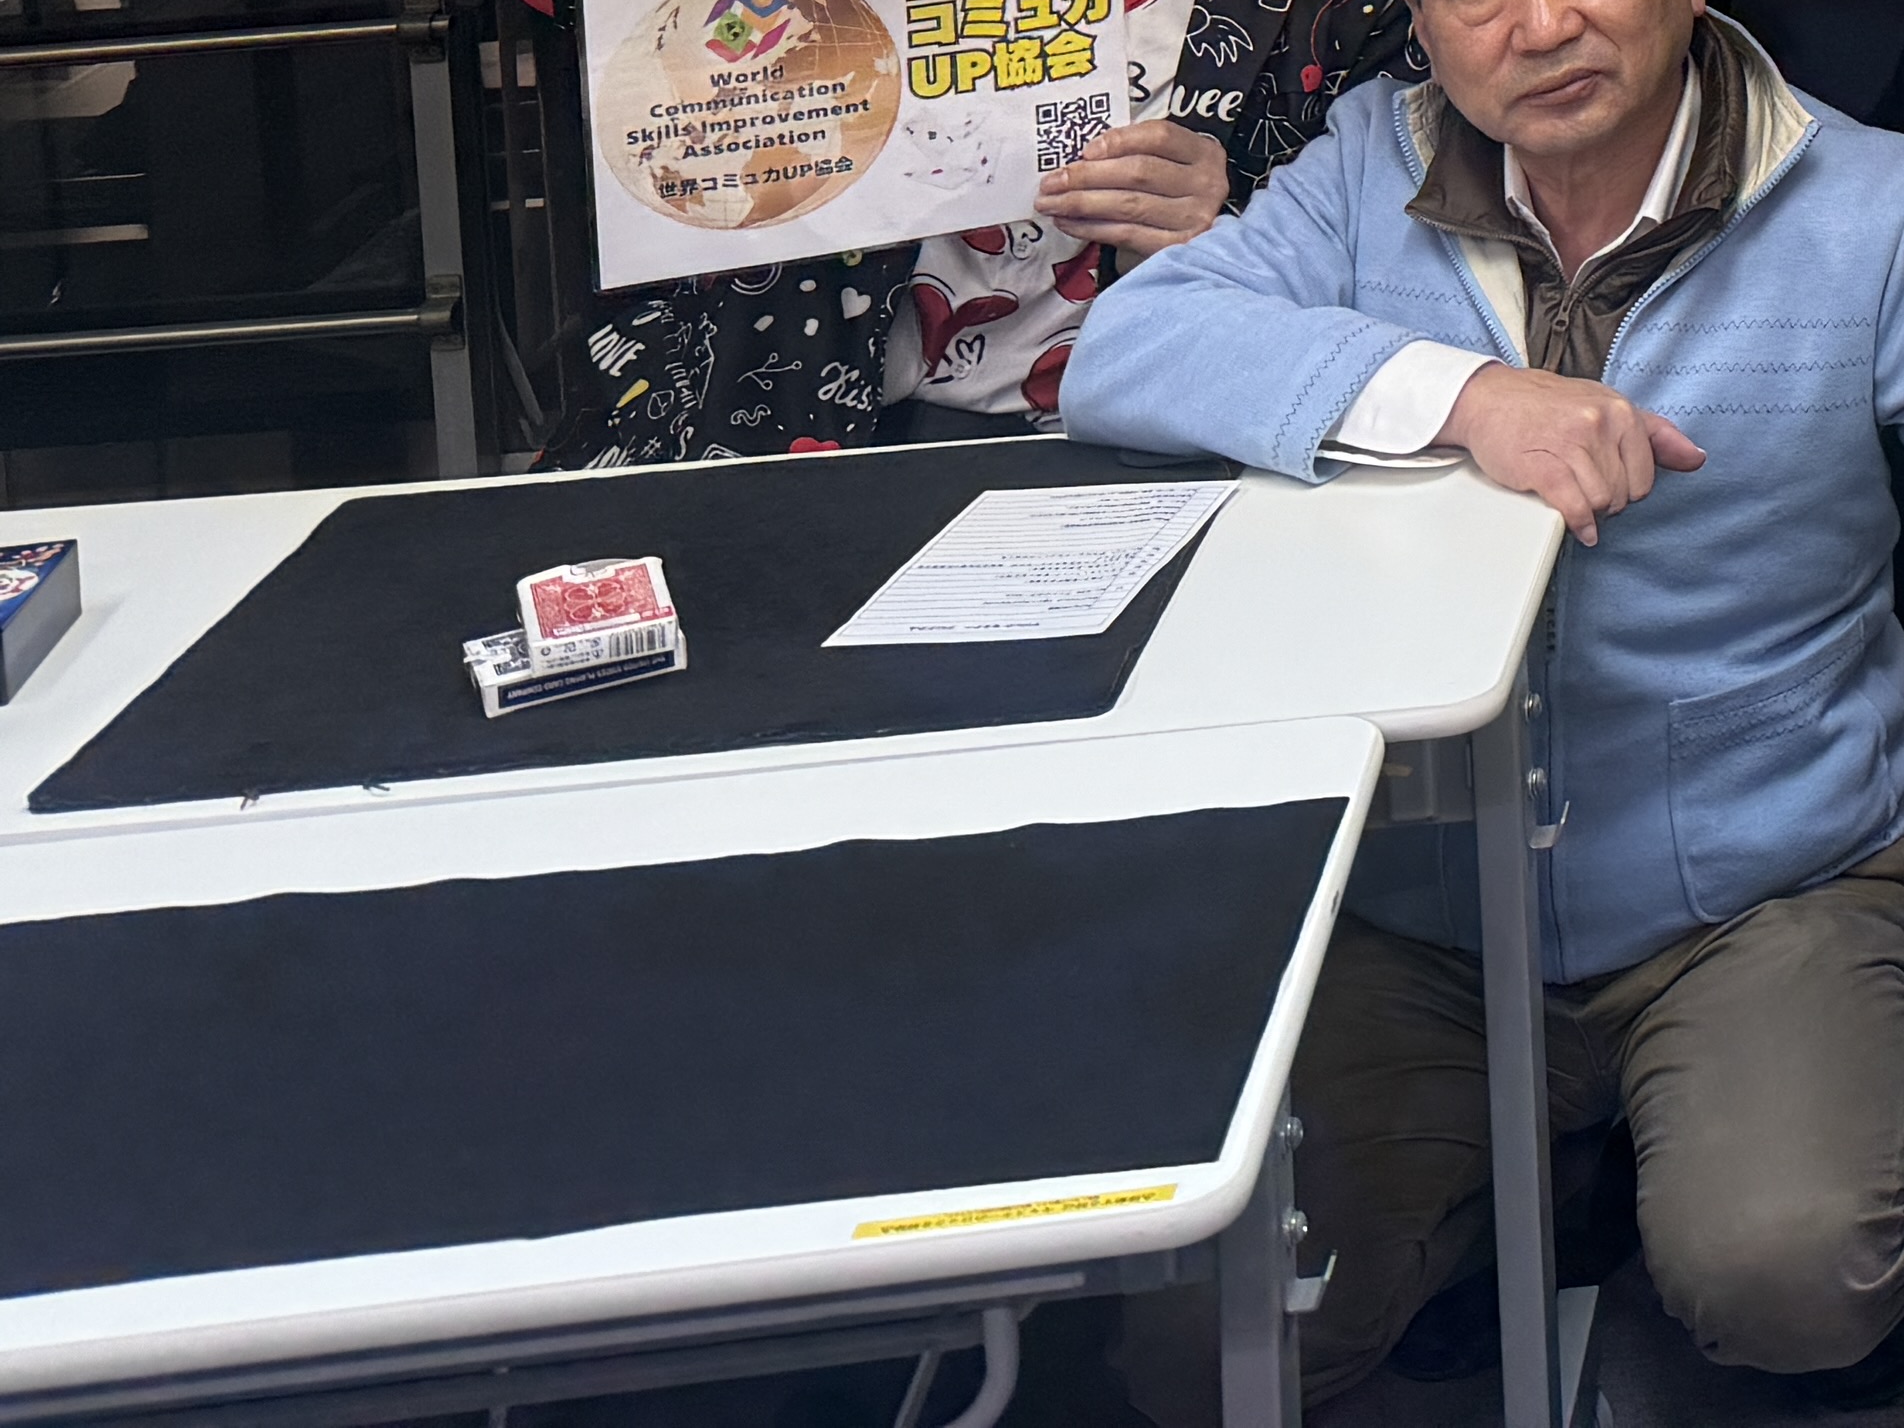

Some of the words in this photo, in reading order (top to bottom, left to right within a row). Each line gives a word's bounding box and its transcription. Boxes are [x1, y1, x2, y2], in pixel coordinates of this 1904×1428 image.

[709, 64, 785, 88] World
[906, 27, 1098, 100] UP協会
[649, 81, 847, 119] Communication
[625, 119, 693, 146] Skills
[701, 97, 871, 136] Improvement
[681, 127, 827, 161] Association
[657, 155, 854, 200] 世界コミュ力UP協会
